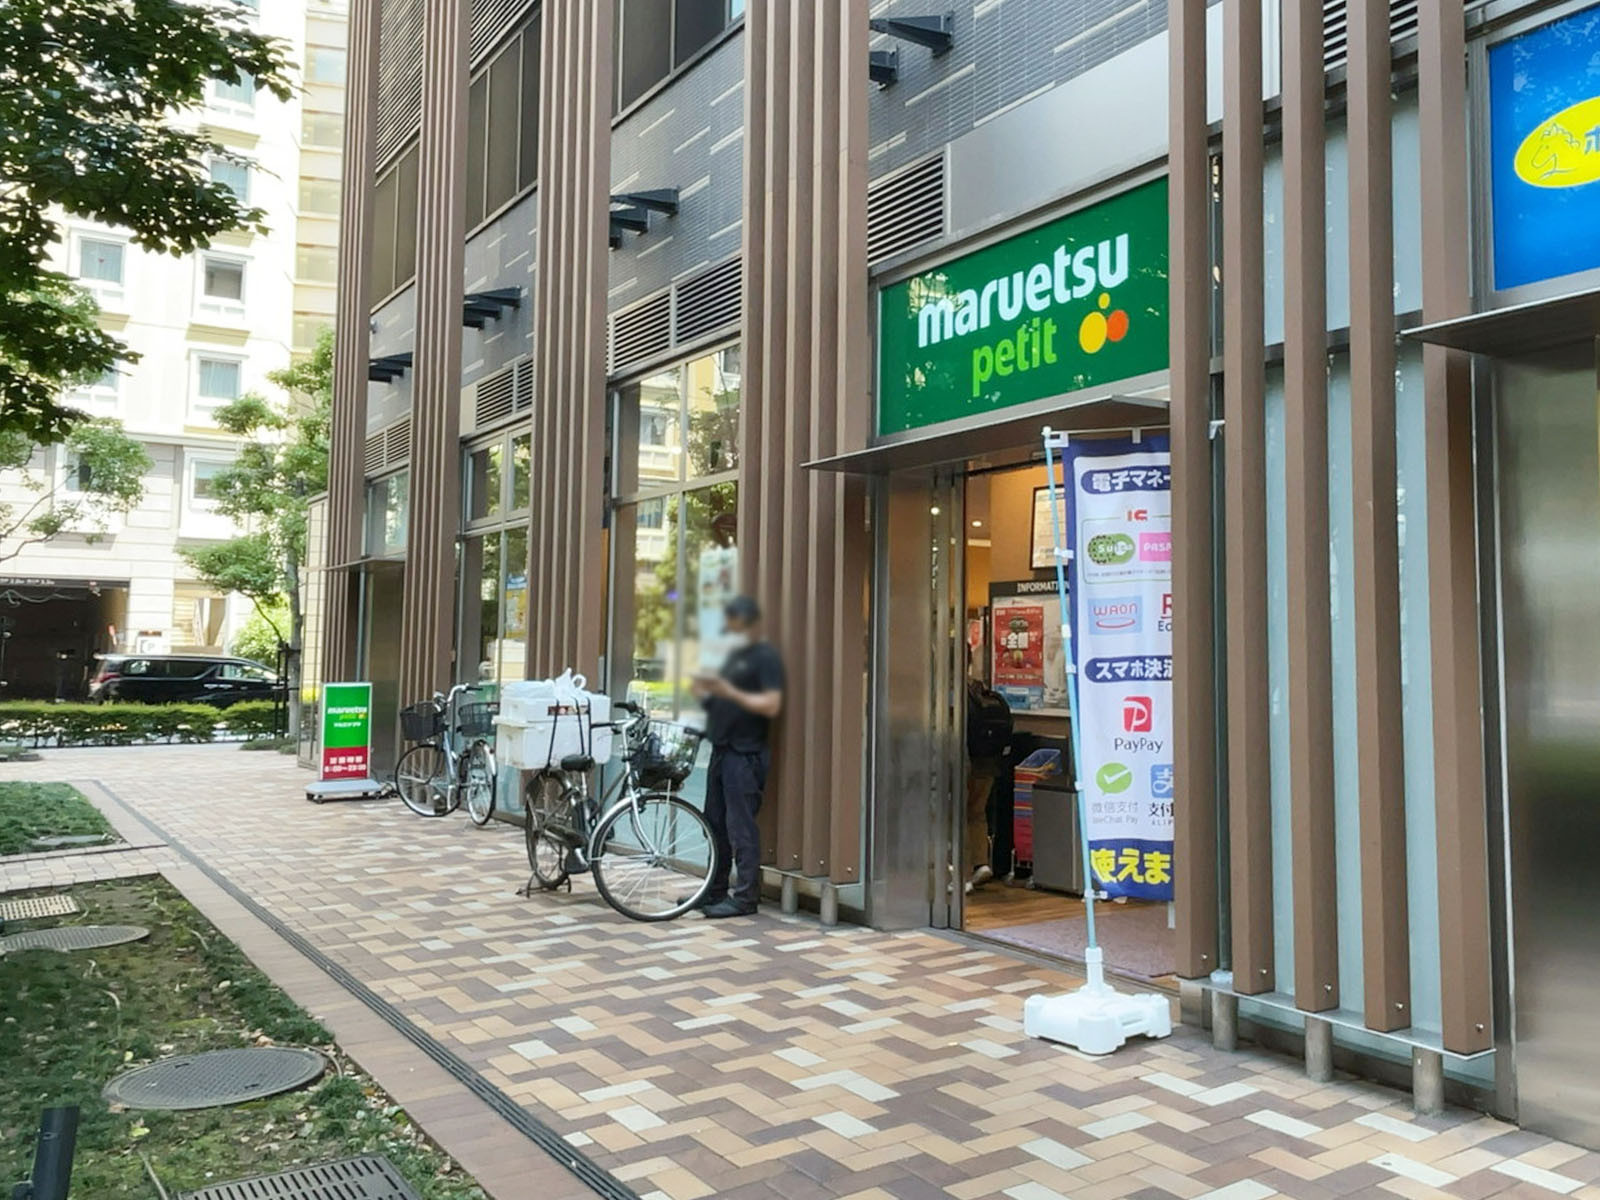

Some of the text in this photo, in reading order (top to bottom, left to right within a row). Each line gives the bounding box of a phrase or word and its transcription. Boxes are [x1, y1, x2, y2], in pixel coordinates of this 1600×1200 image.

[917, 233, 1129, 348] maruetsu
[972, 317, 1057, 397] petit
[1114, 737, 1163, 753] PayPay
